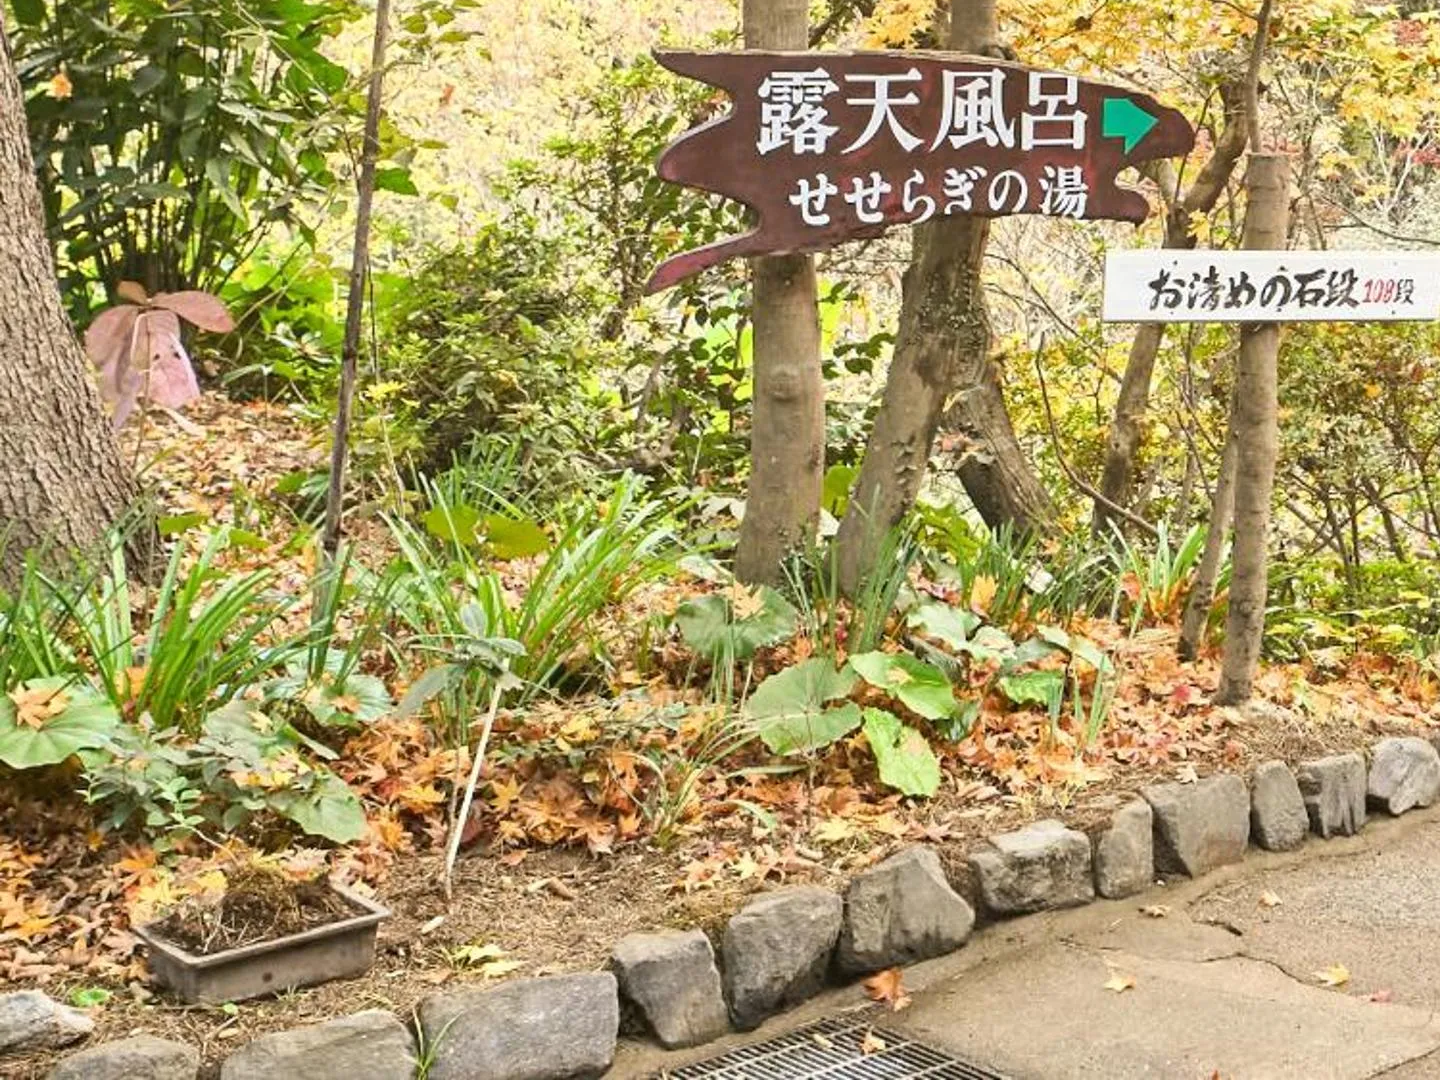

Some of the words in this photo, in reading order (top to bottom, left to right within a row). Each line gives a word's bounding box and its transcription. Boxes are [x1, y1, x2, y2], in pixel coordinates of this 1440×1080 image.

[756, 67, 1088, 155] 露天風呂
[789, 165, 1089, 226] せせらぎの湯
